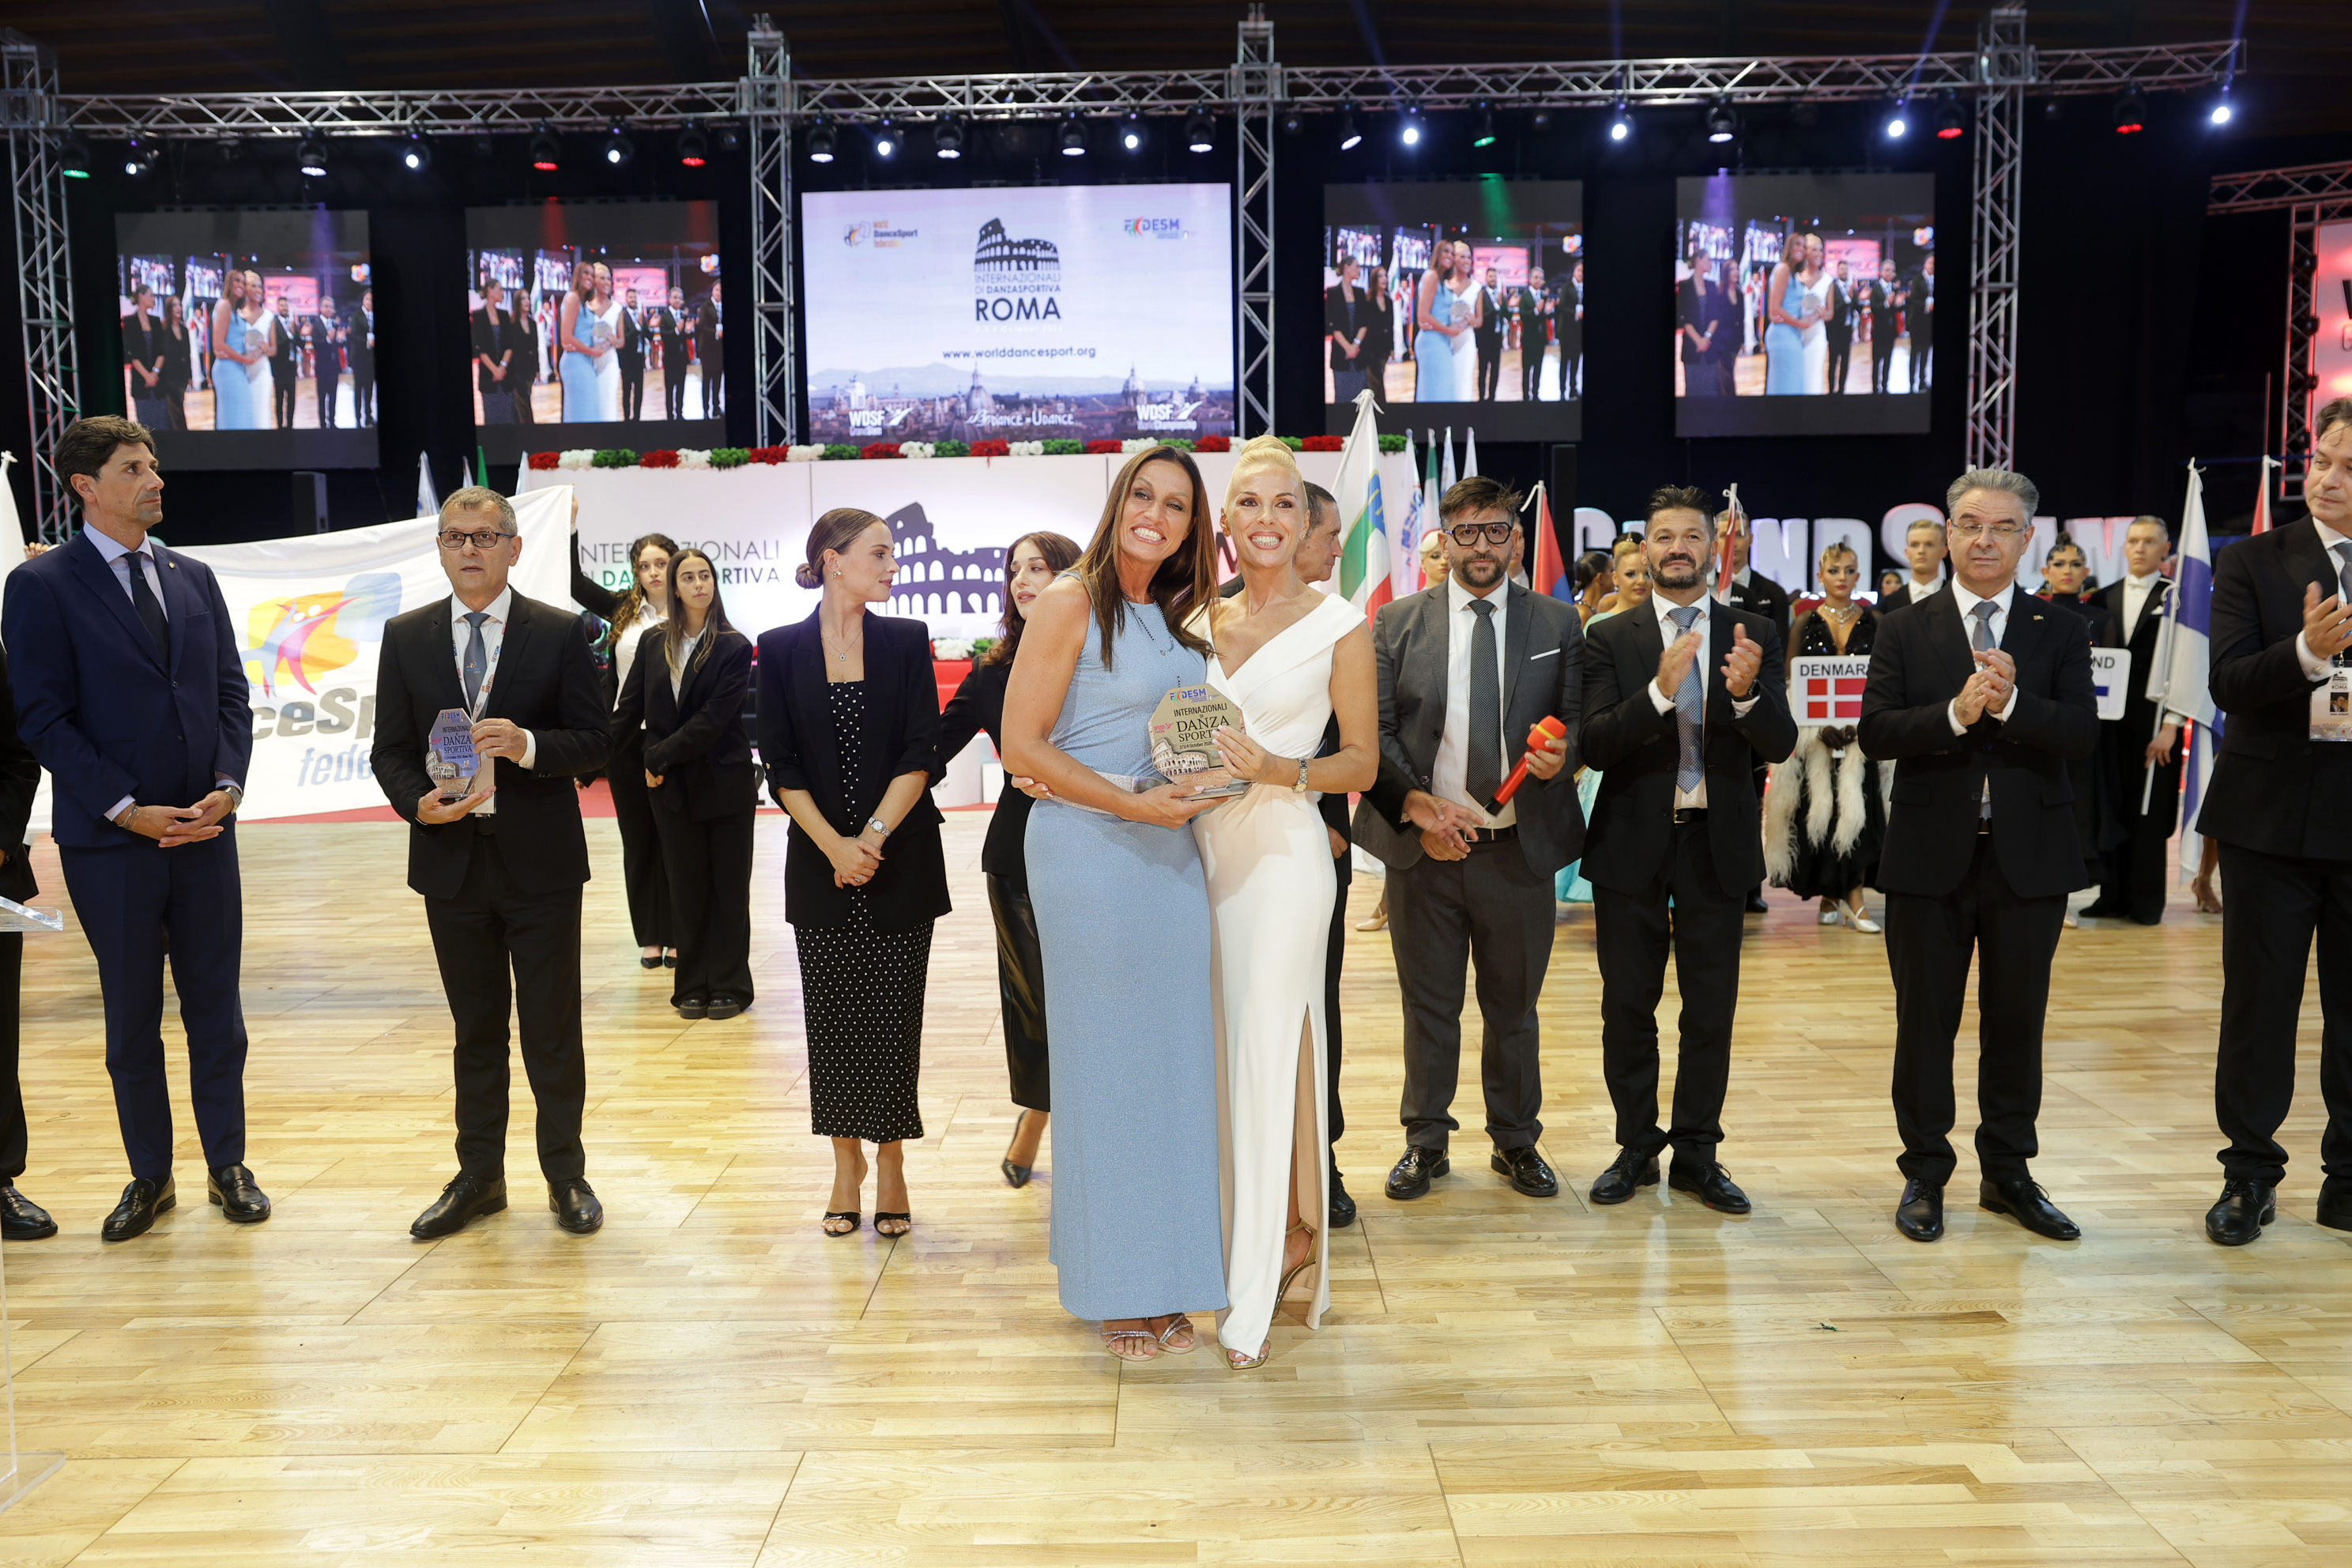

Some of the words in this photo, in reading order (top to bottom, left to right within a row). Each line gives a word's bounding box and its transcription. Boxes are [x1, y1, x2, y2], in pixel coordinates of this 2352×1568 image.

[974, 273, 1061, 284] INTERNAZIONALI
[987, 285, 1061, 294] DANZASPORTIVA
[975, 297, 1061, 321] ROMA
[942, 345, 1096, 359] www.worlddancesport.org
[849, 410, 885, 427] WDSF
[1136, 404, 1174, 420] WDSF
[1800, 663, 1870, 677] DENMAR
[1174, 703, 1227, 717] INTERNAZIONALI
[1176, 715, 1230, 732] DANZA
[443, 735, 472, 746] DANZA
[444, 745, 473, 754] SPORTIVA
